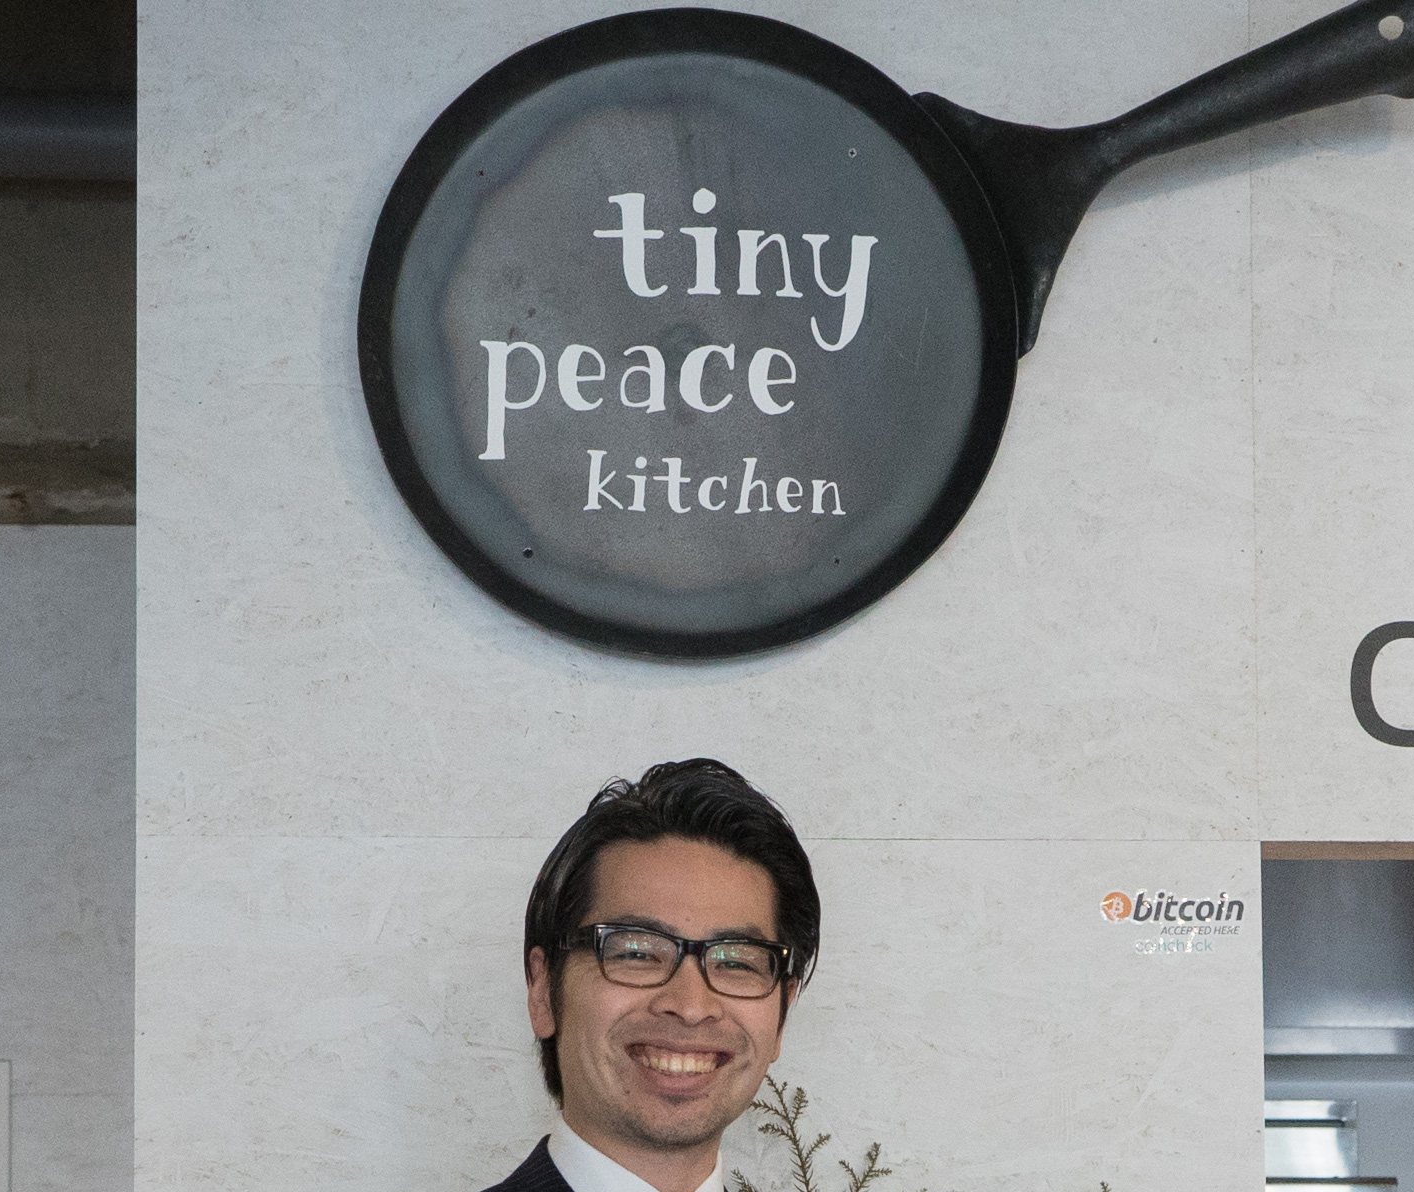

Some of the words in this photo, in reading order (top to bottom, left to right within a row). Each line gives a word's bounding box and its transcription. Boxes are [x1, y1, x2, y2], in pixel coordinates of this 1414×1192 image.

[593, 188, 877, 352] tiny
[478, 339, 796, 460] peace
[583, 450, 846, 516] kitchen
[1132, 891, 1244, 922] bitcoin
[1160, 925, 1212, 935] ACCEPED
[1213, 925, 1240, 935] HERE
